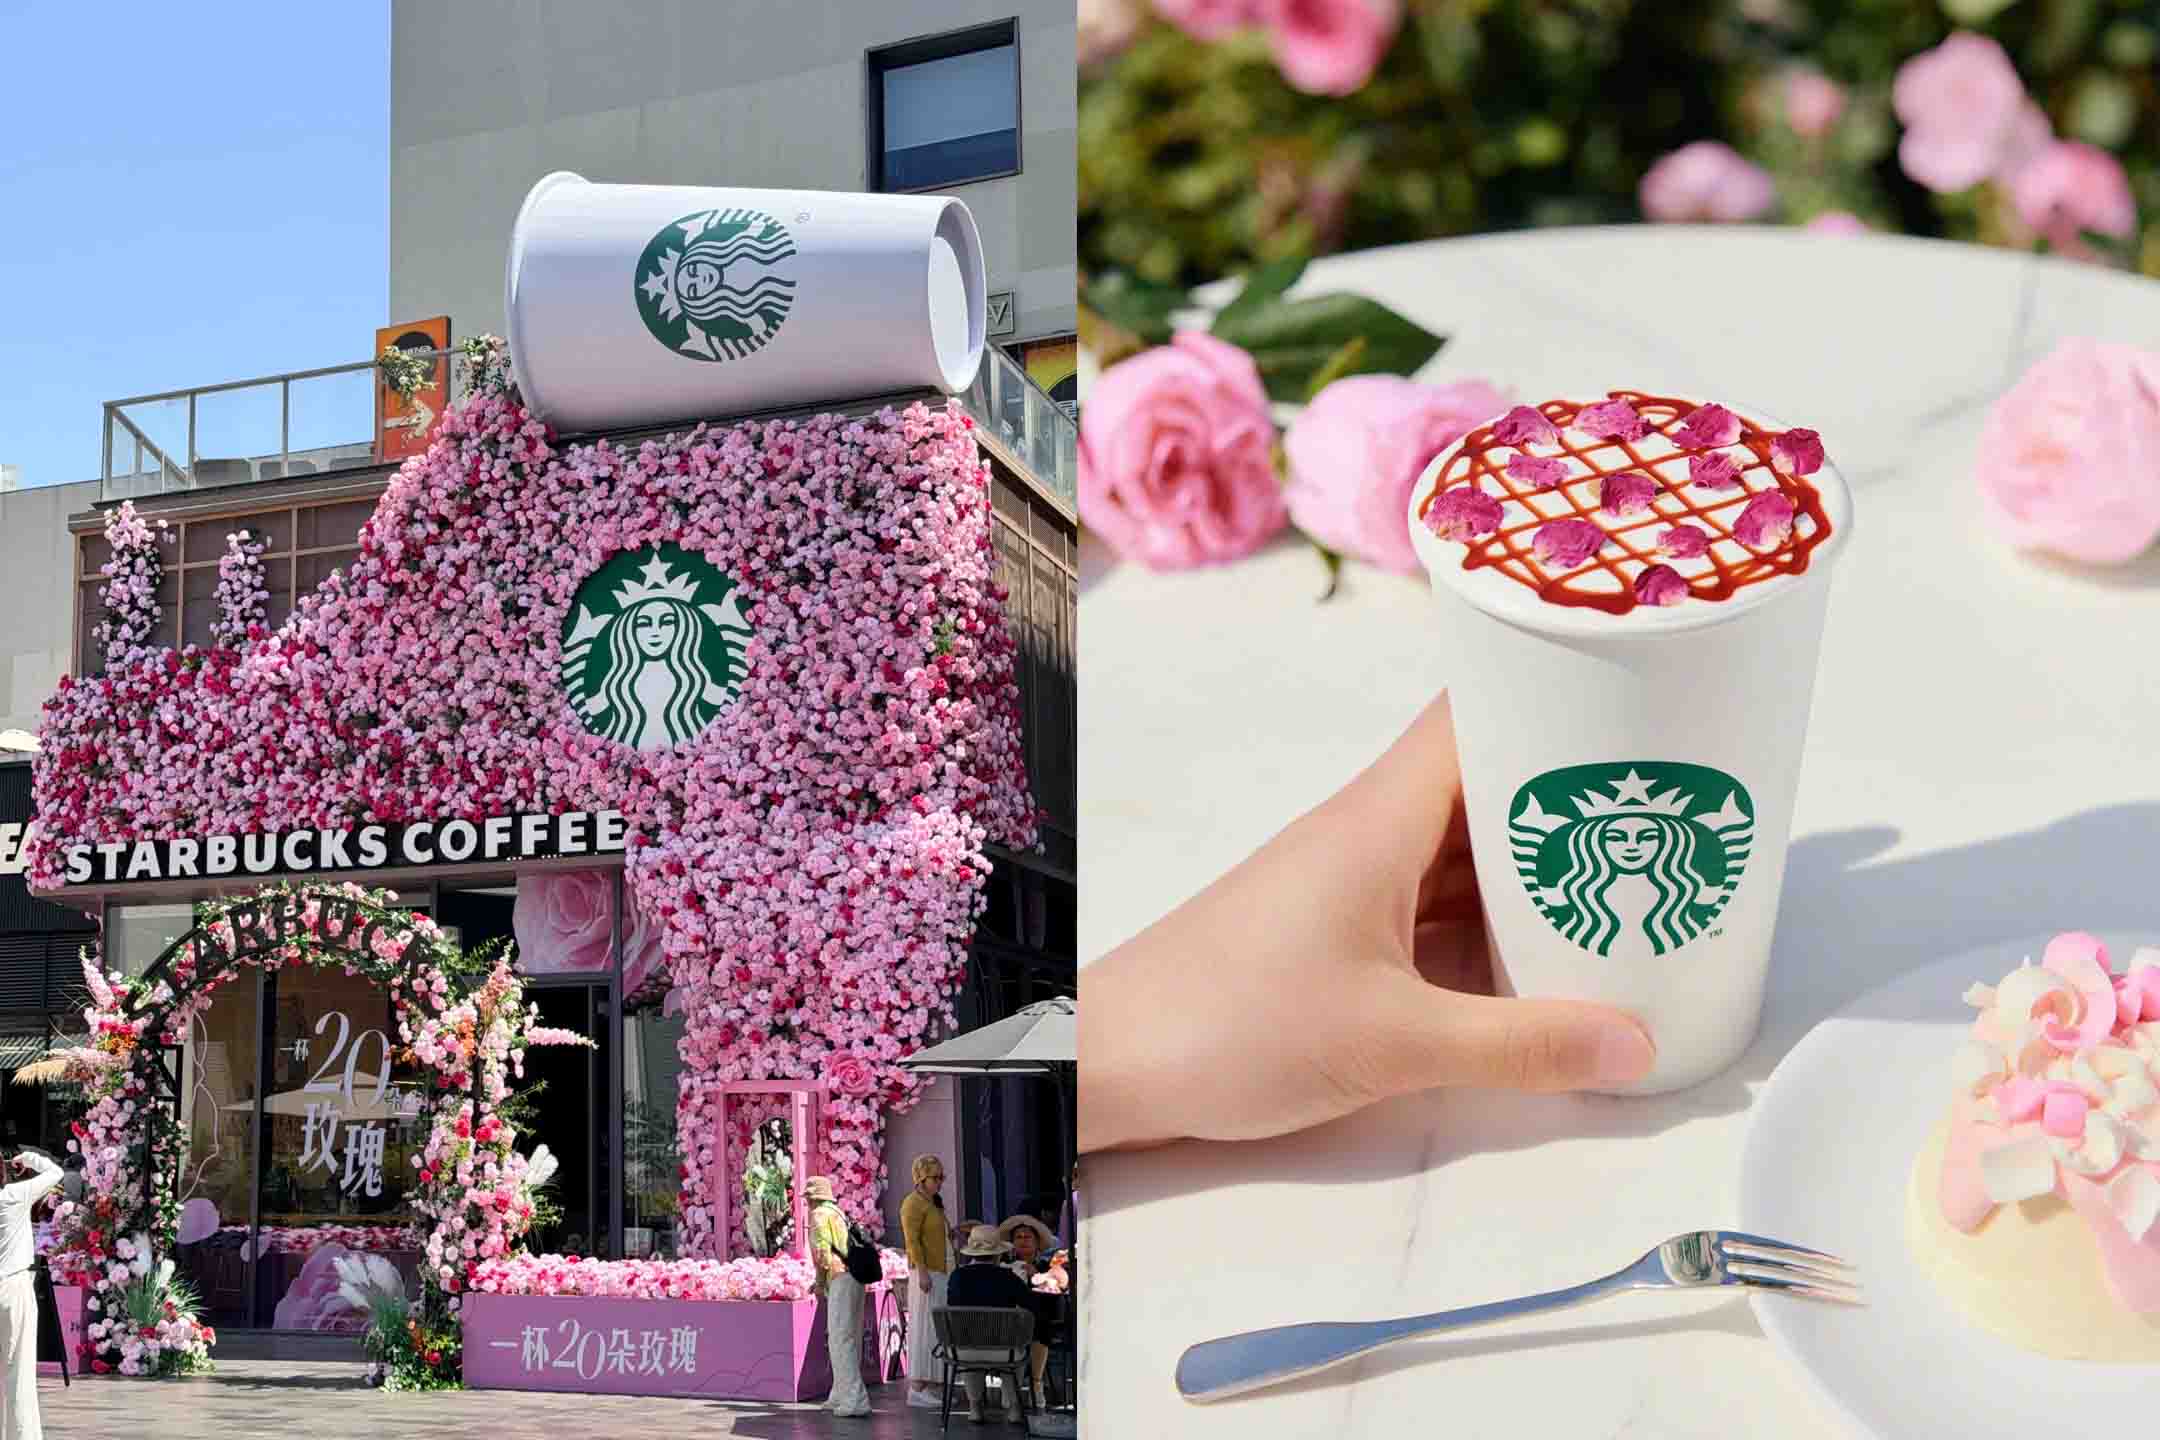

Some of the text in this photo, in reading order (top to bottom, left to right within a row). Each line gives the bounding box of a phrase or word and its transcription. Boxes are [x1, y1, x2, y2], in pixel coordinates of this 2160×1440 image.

[66, 809, 626, 883] STARBUCKS COFFEE
[304, 1011, 391, 1112] 20
[298, 1100, 386, 1198] 玫瑰
[488, 1319, 698, 1381] 一杯20朵玫瑰
